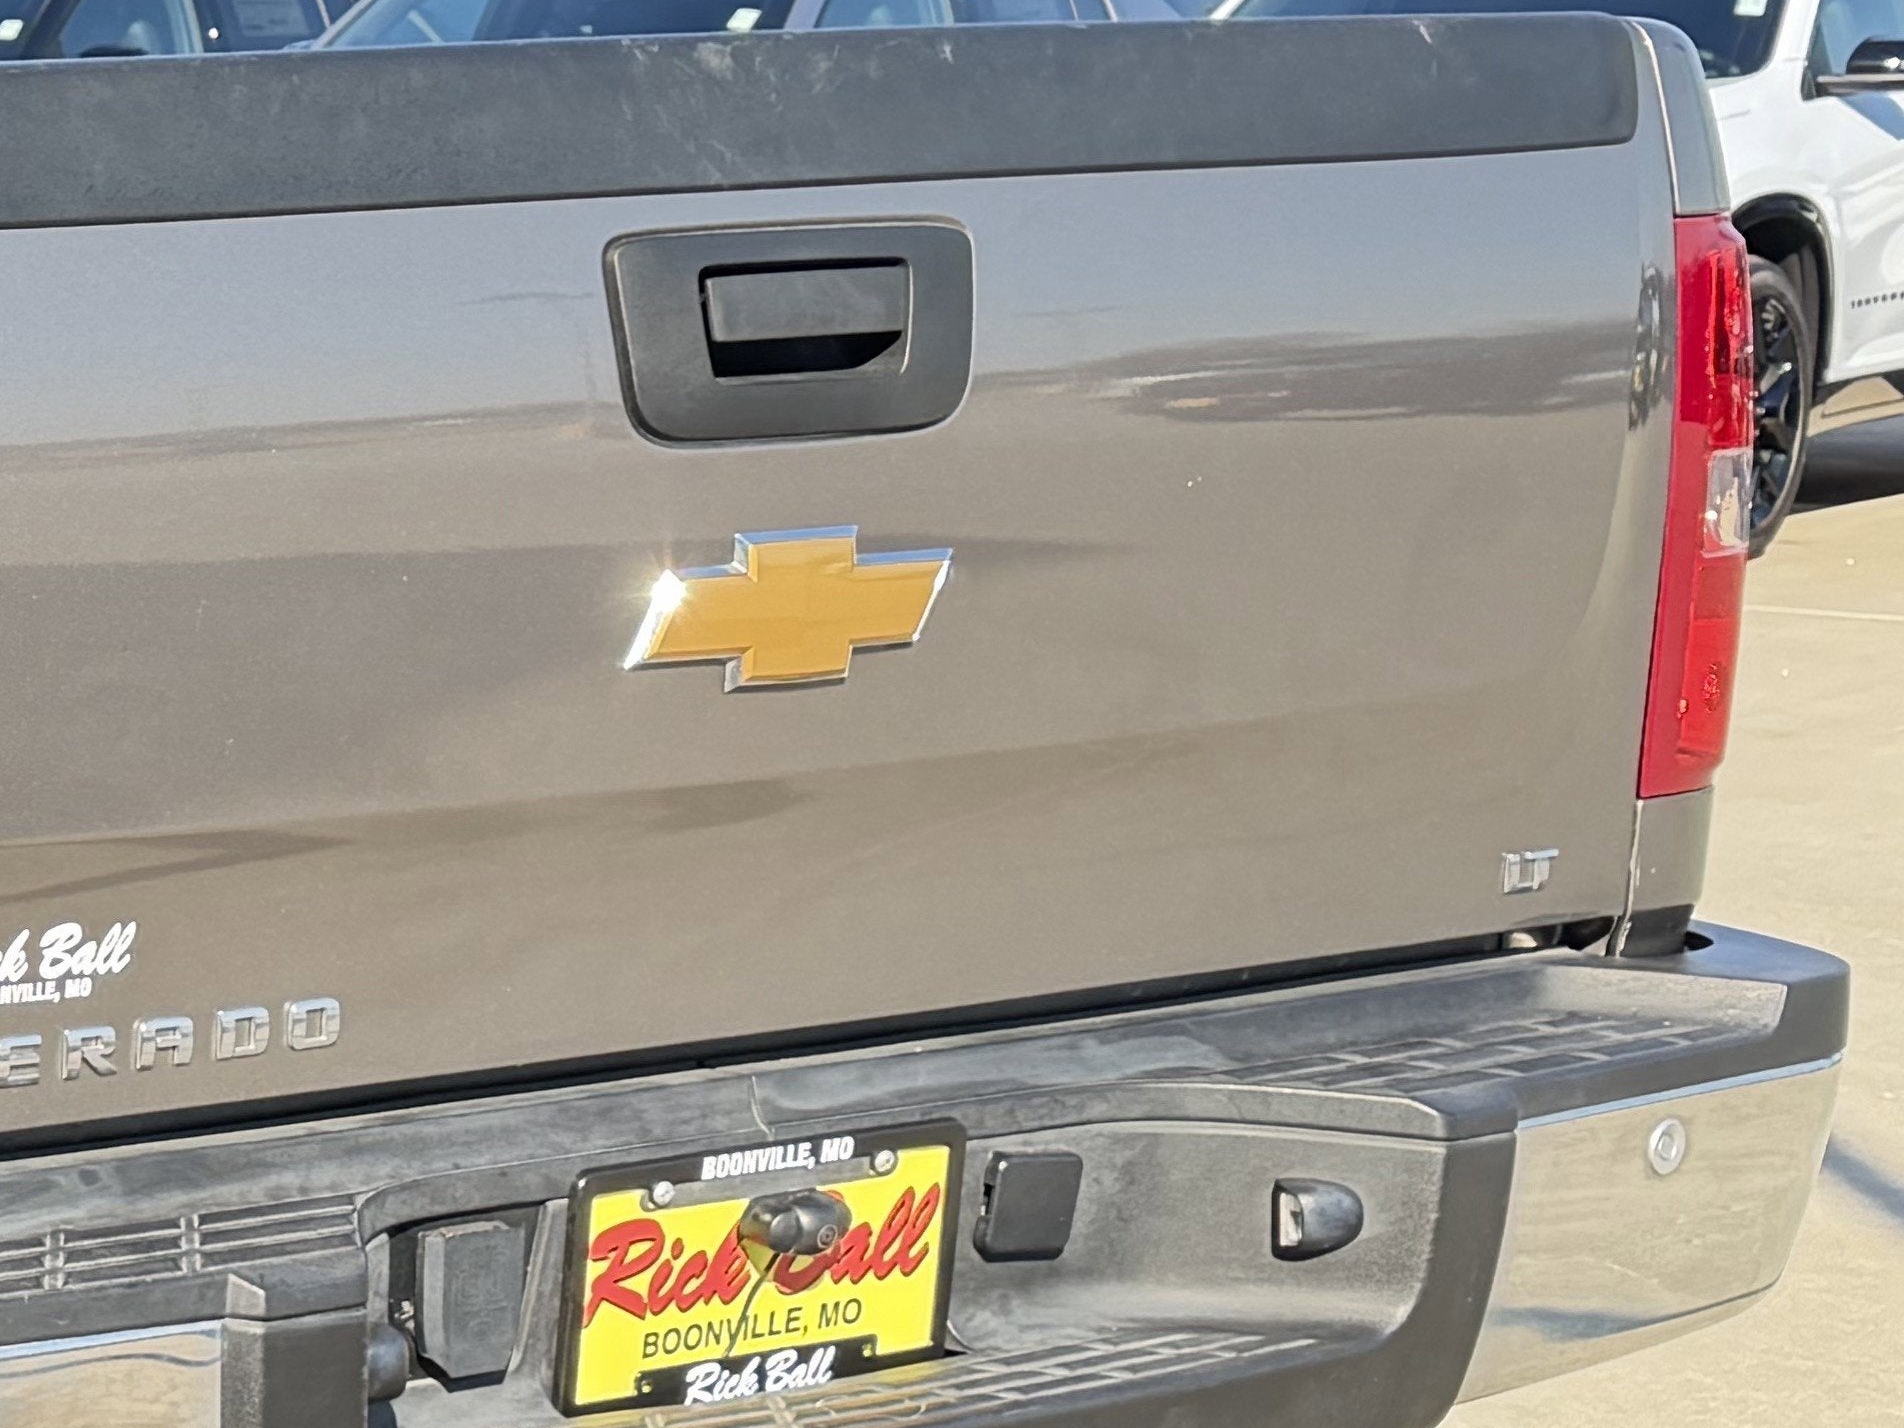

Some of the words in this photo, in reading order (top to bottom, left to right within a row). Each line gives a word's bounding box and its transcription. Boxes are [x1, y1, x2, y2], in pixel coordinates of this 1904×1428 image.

[1501, 848, 1560, 894] LT
[39, 921, 137, 980] Ball
[65, 977, 92, 998] MO
[701, 1141, 816, 1181] BOONVILLE,
[821, 1135, 854, 1164] MO
[583, 1218, 752, 1329] Rick
[642, 1306, 808, 1359] BOONVILLE,
[817, 1298, 863, 1329] MO
[683, 1357, 762, 1406] Rick
[764, 1344, 837, 1393] Ball
